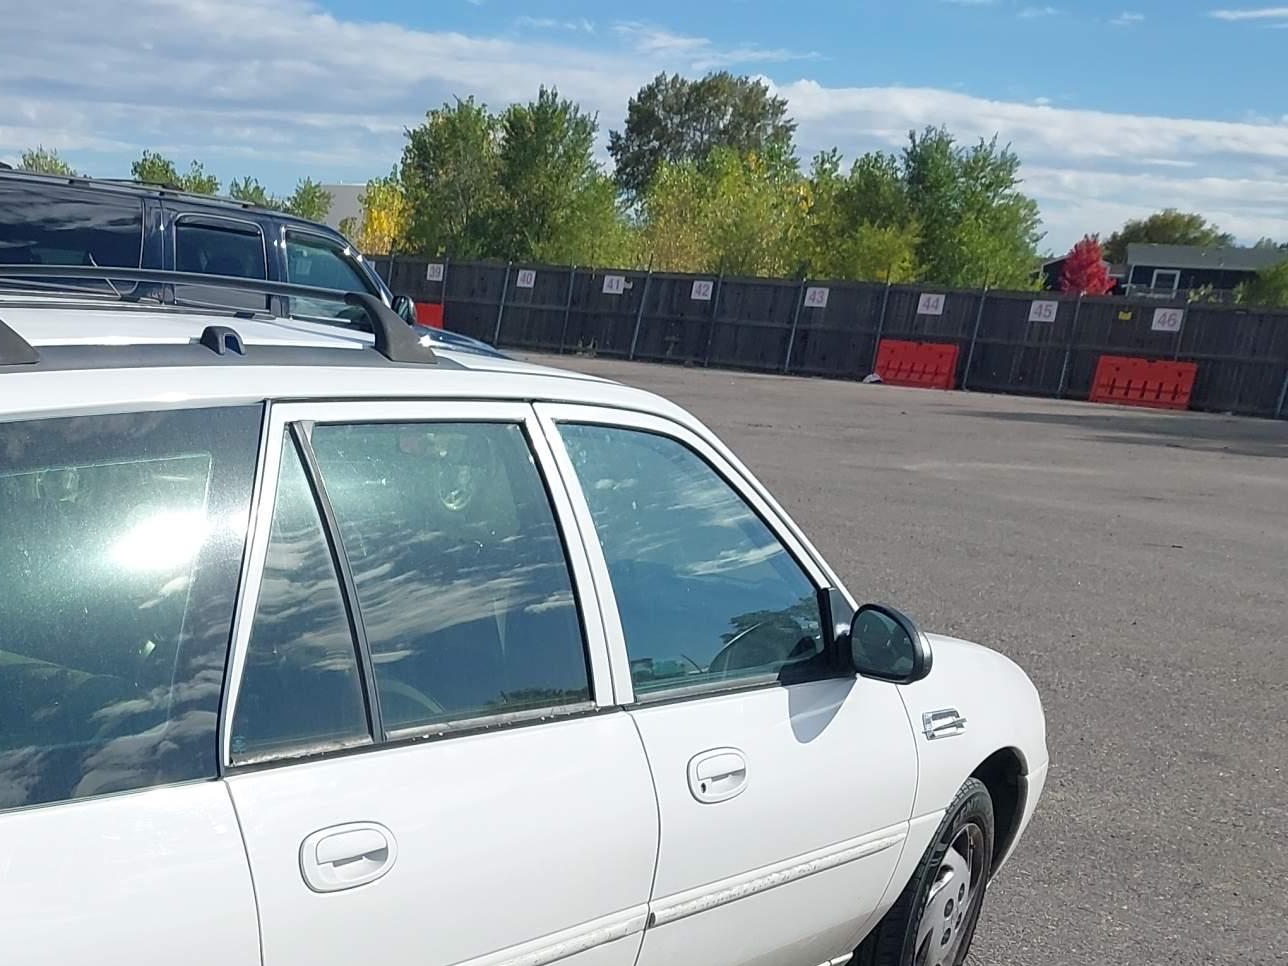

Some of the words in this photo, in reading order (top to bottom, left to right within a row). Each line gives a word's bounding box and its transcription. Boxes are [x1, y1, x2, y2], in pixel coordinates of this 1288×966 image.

[428, 265, 441, 278] 39
[520, 271, 533, 284] 40
[607, 277, 620, 290] 41
[694, 283, 710, 298] 42
[808, 290, 824, 304] 43
[921, 296, 939, 311] 44
[1033, 303, 1053, 319] 45
[1157, 312, 1177, 328] 46
